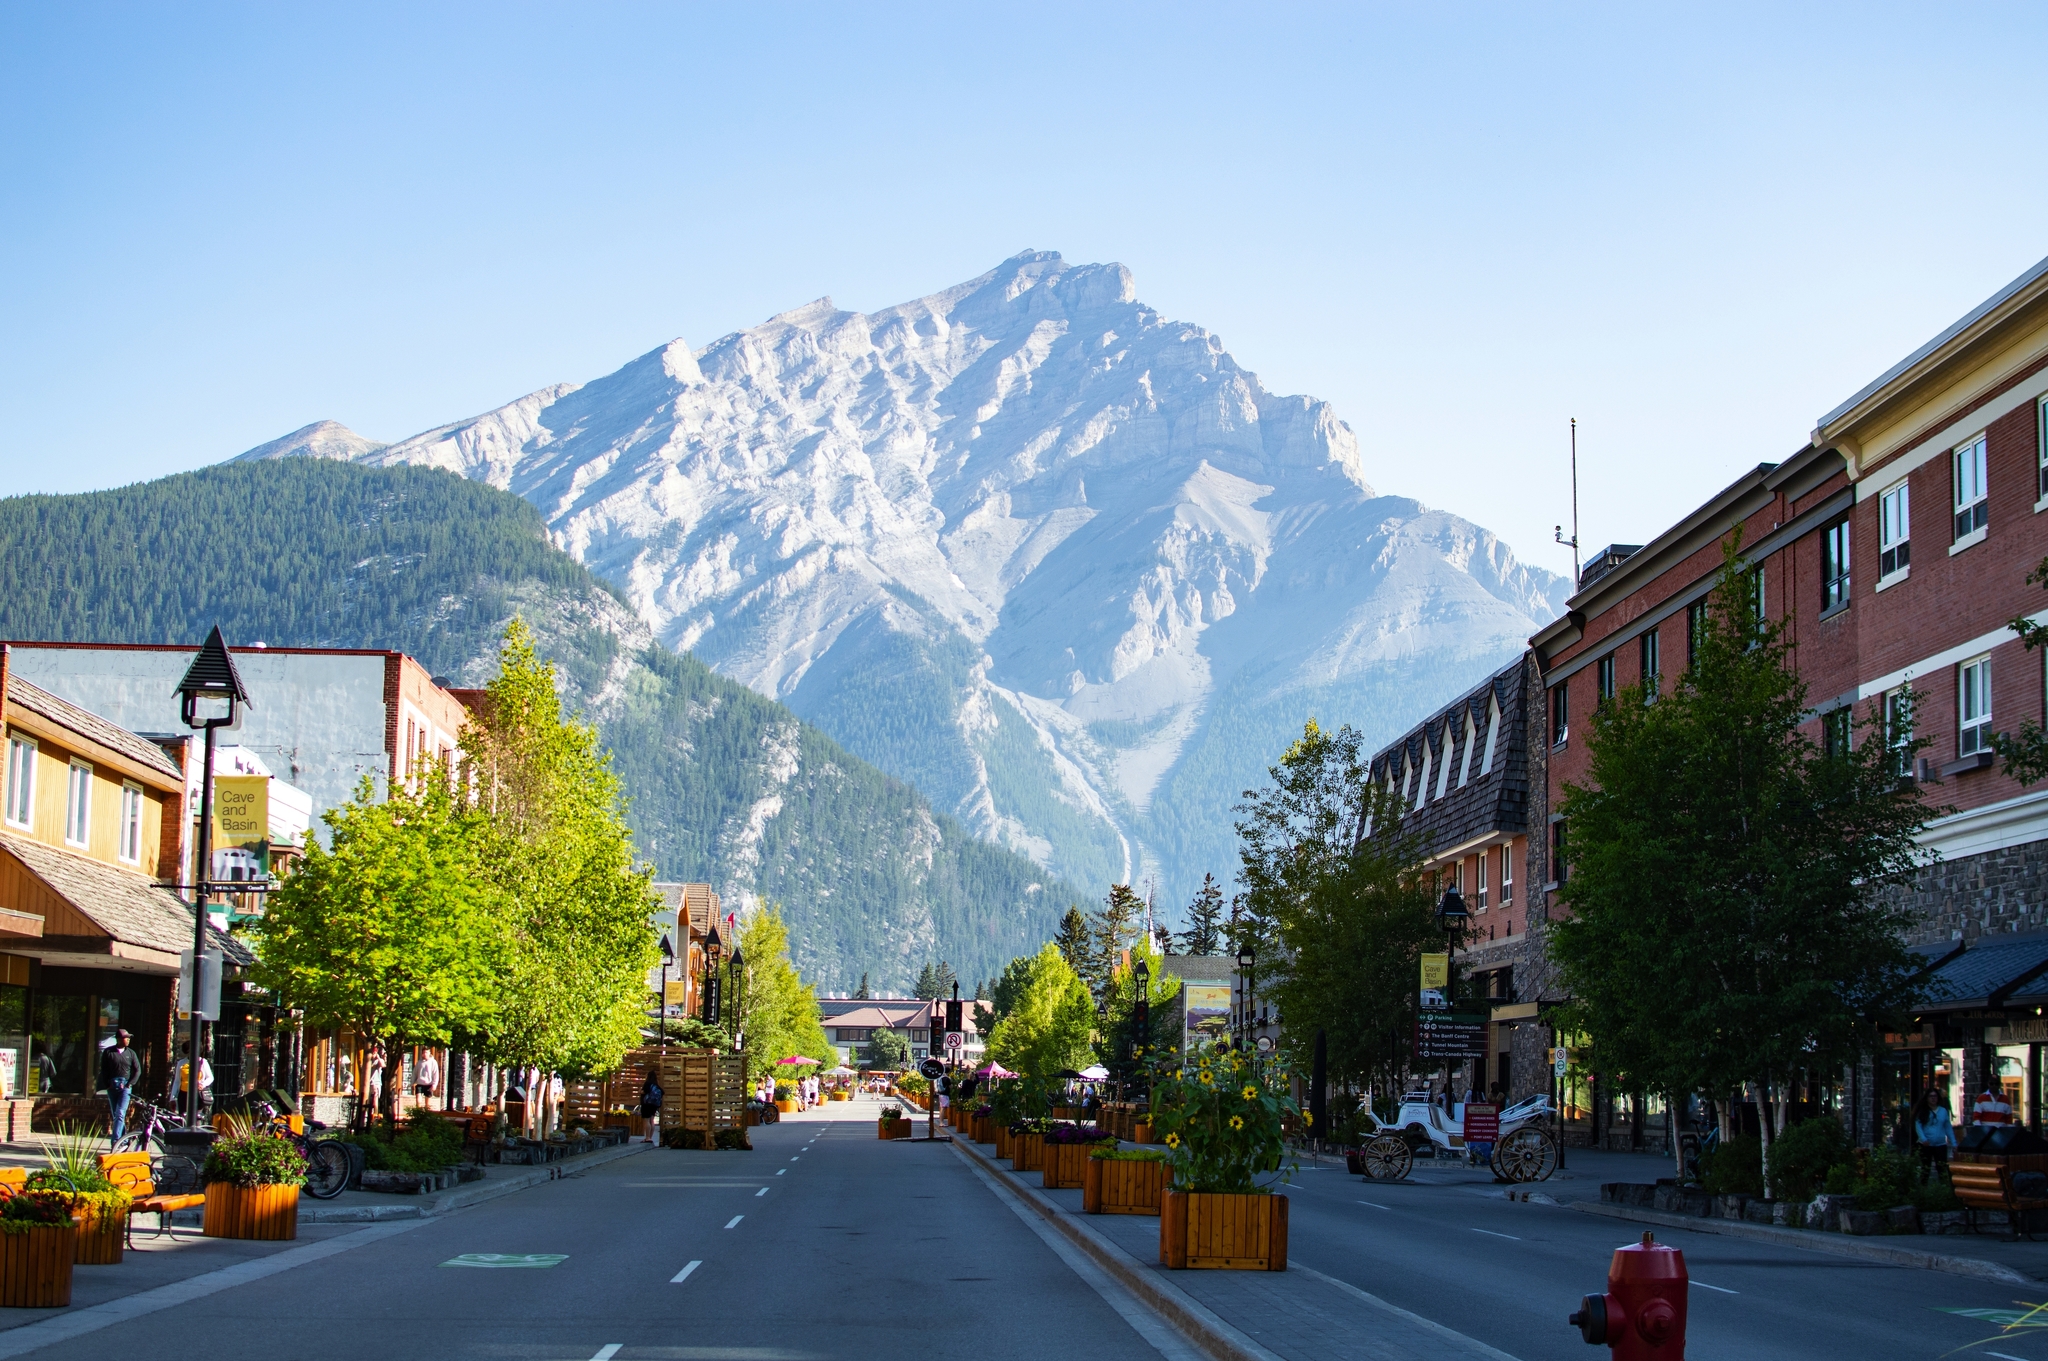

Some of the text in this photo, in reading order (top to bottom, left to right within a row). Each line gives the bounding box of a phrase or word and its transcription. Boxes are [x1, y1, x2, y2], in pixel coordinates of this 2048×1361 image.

[222, 791, 254, 802] Cave
[222, 804, 246, 816] and
[222, 818, 258, 830] Basin
